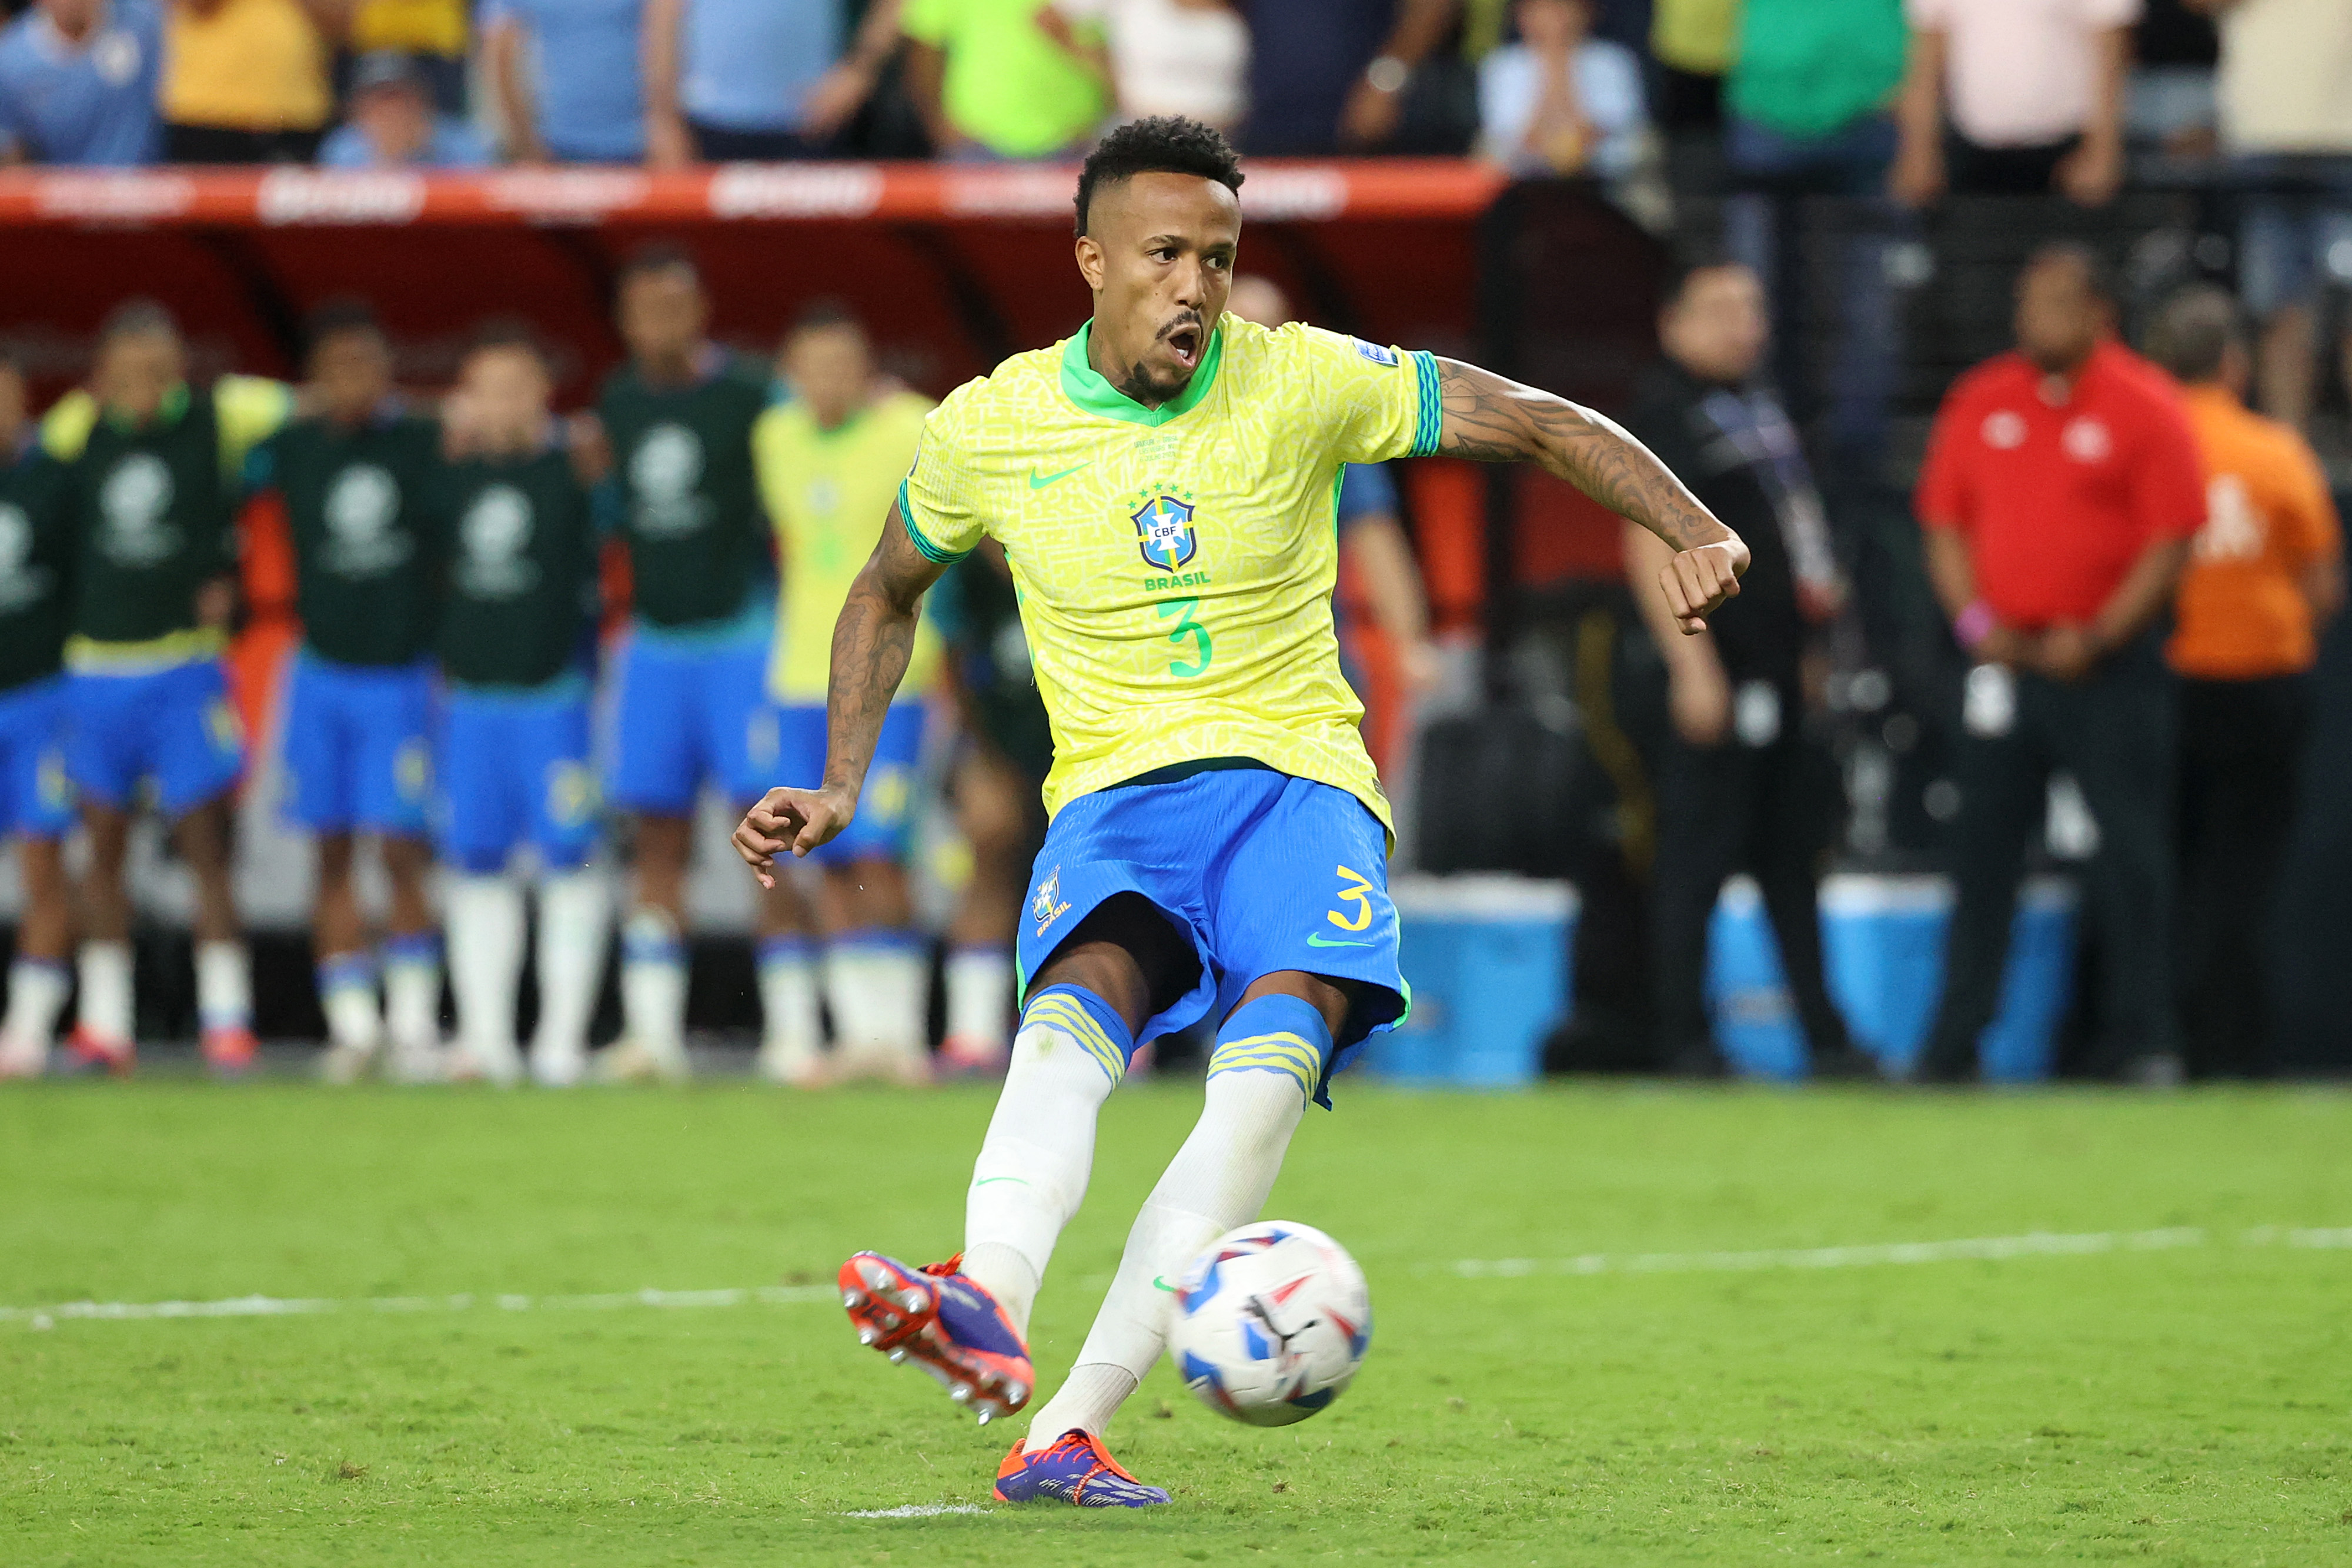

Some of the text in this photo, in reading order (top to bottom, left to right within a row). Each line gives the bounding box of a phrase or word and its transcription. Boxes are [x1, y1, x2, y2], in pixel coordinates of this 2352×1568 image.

[1145, 453, 1161, 462] JULHO
[1154, 526, 1177, 537] CBF
[1144, 571, 1211, 591] BRASIL
[1155, 596, 1212, 677] 3
[1327, 865, 1374, 931] 3
[1036, 901, 1073, 937] BRASIL
